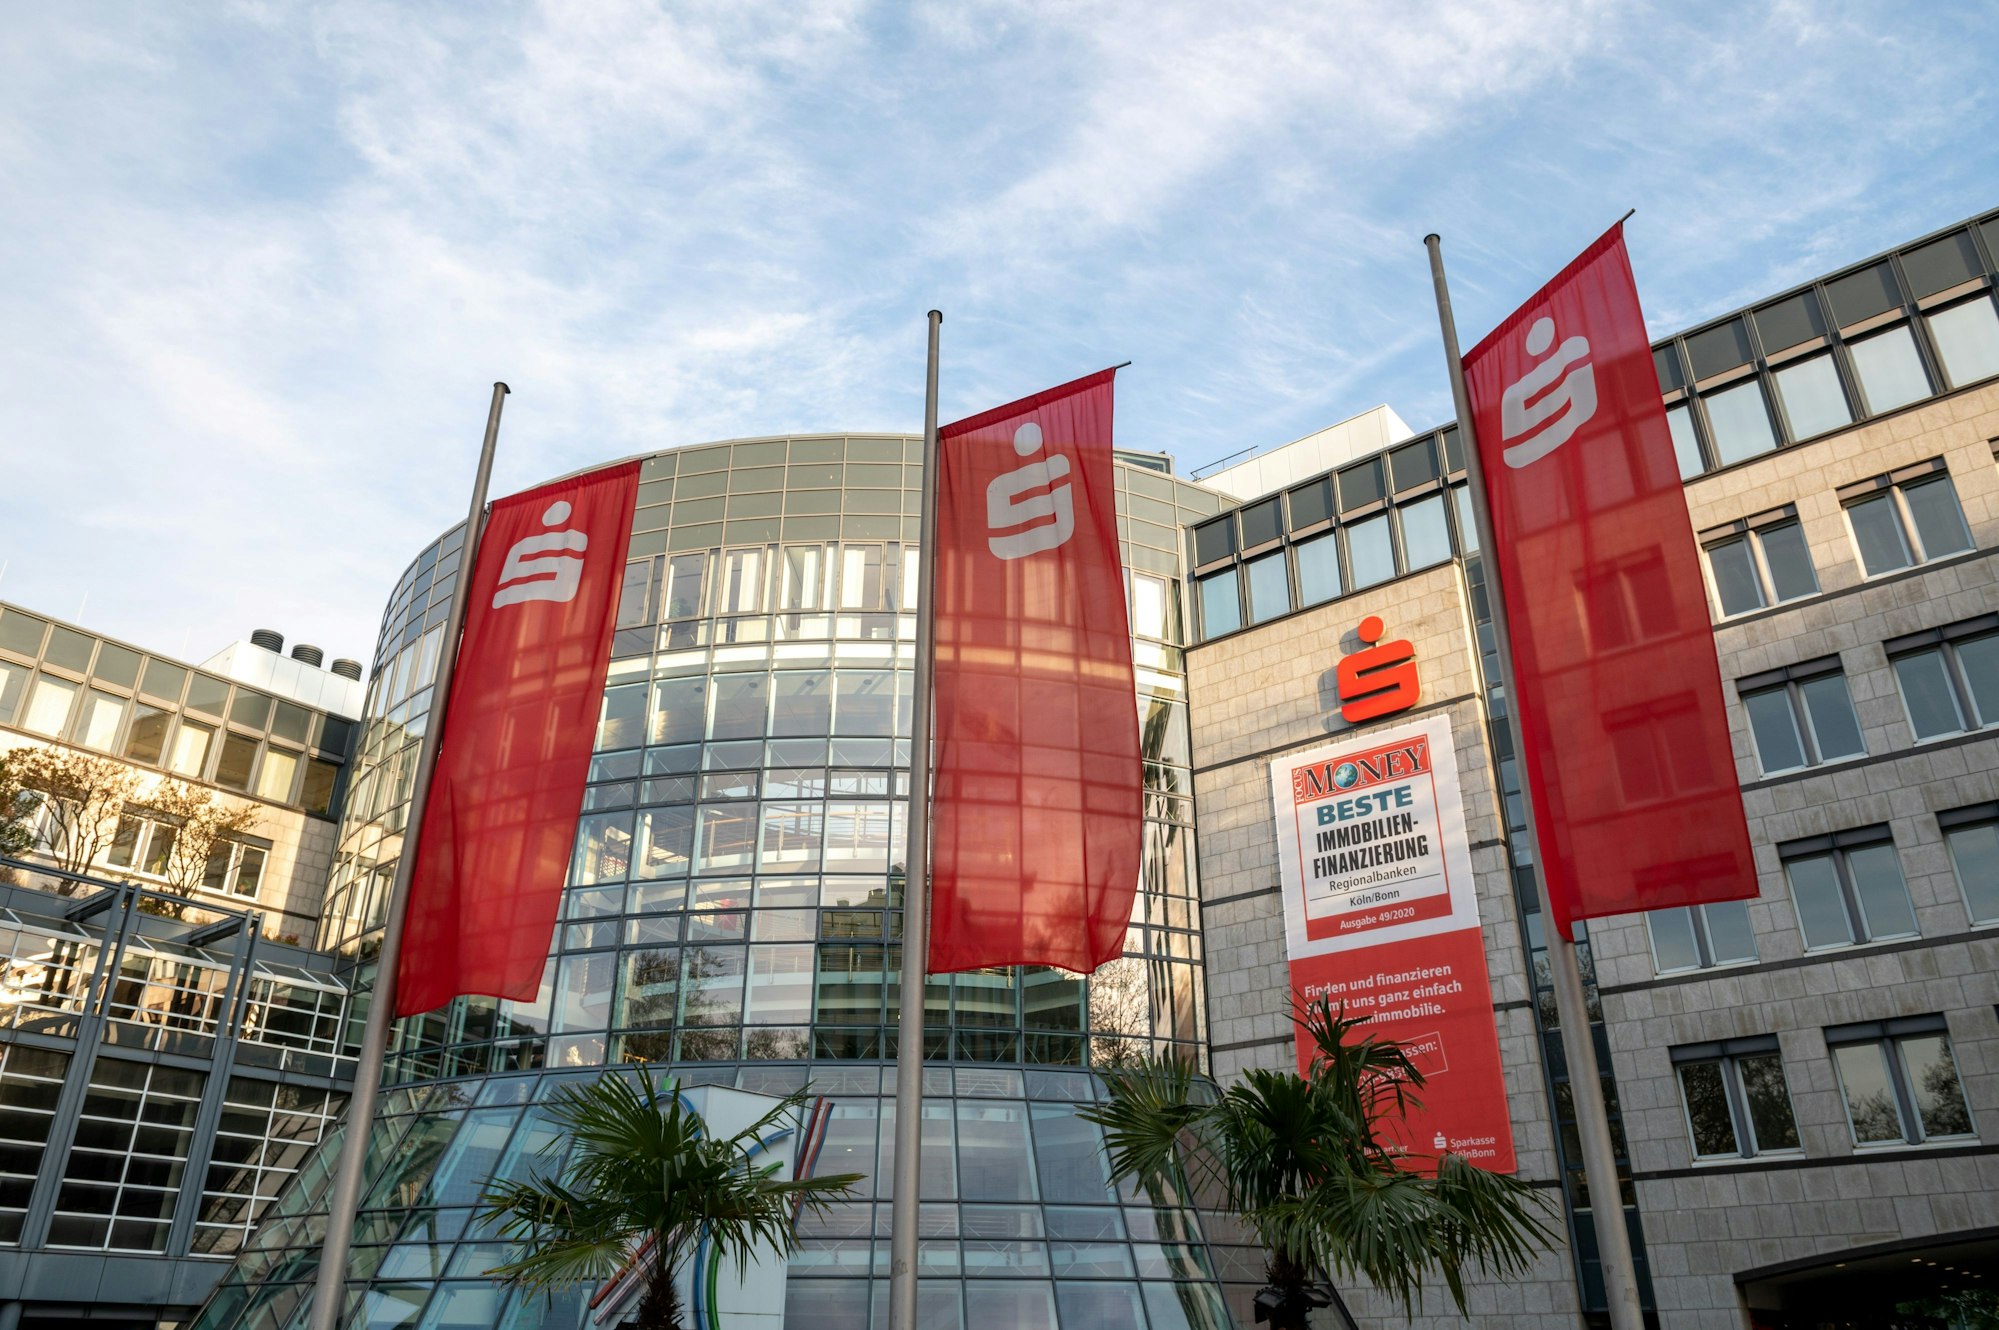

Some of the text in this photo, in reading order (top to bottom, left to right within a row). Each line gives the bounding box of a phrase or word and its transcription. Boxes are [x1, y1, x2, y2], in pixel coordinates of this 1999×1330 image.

[1293, 768, 1305, 803] FOCUS
[1316, 784, 1413, 826] BESTE
[1316, 812, 1419, 853] IMMOBILIEN-
[1313, 834, 1429, 879] FINANZIERUNG
[1329, 865, 1417, 892] Regionalbanken
[1350, 889, 1400, 907] Köln/Bonn
[1340, 907, 1415, 930] Ausgabe 49/2020
[1304, 965, 1452, 998] Finden und finanzieren
[1352, 995, 1376, 1008] uns
[1378, 990, 1410, 1007] ganz
[1413, 979, 1463, 998] einfach
[1450, 1136, 1496, 1150] Sparkasse
